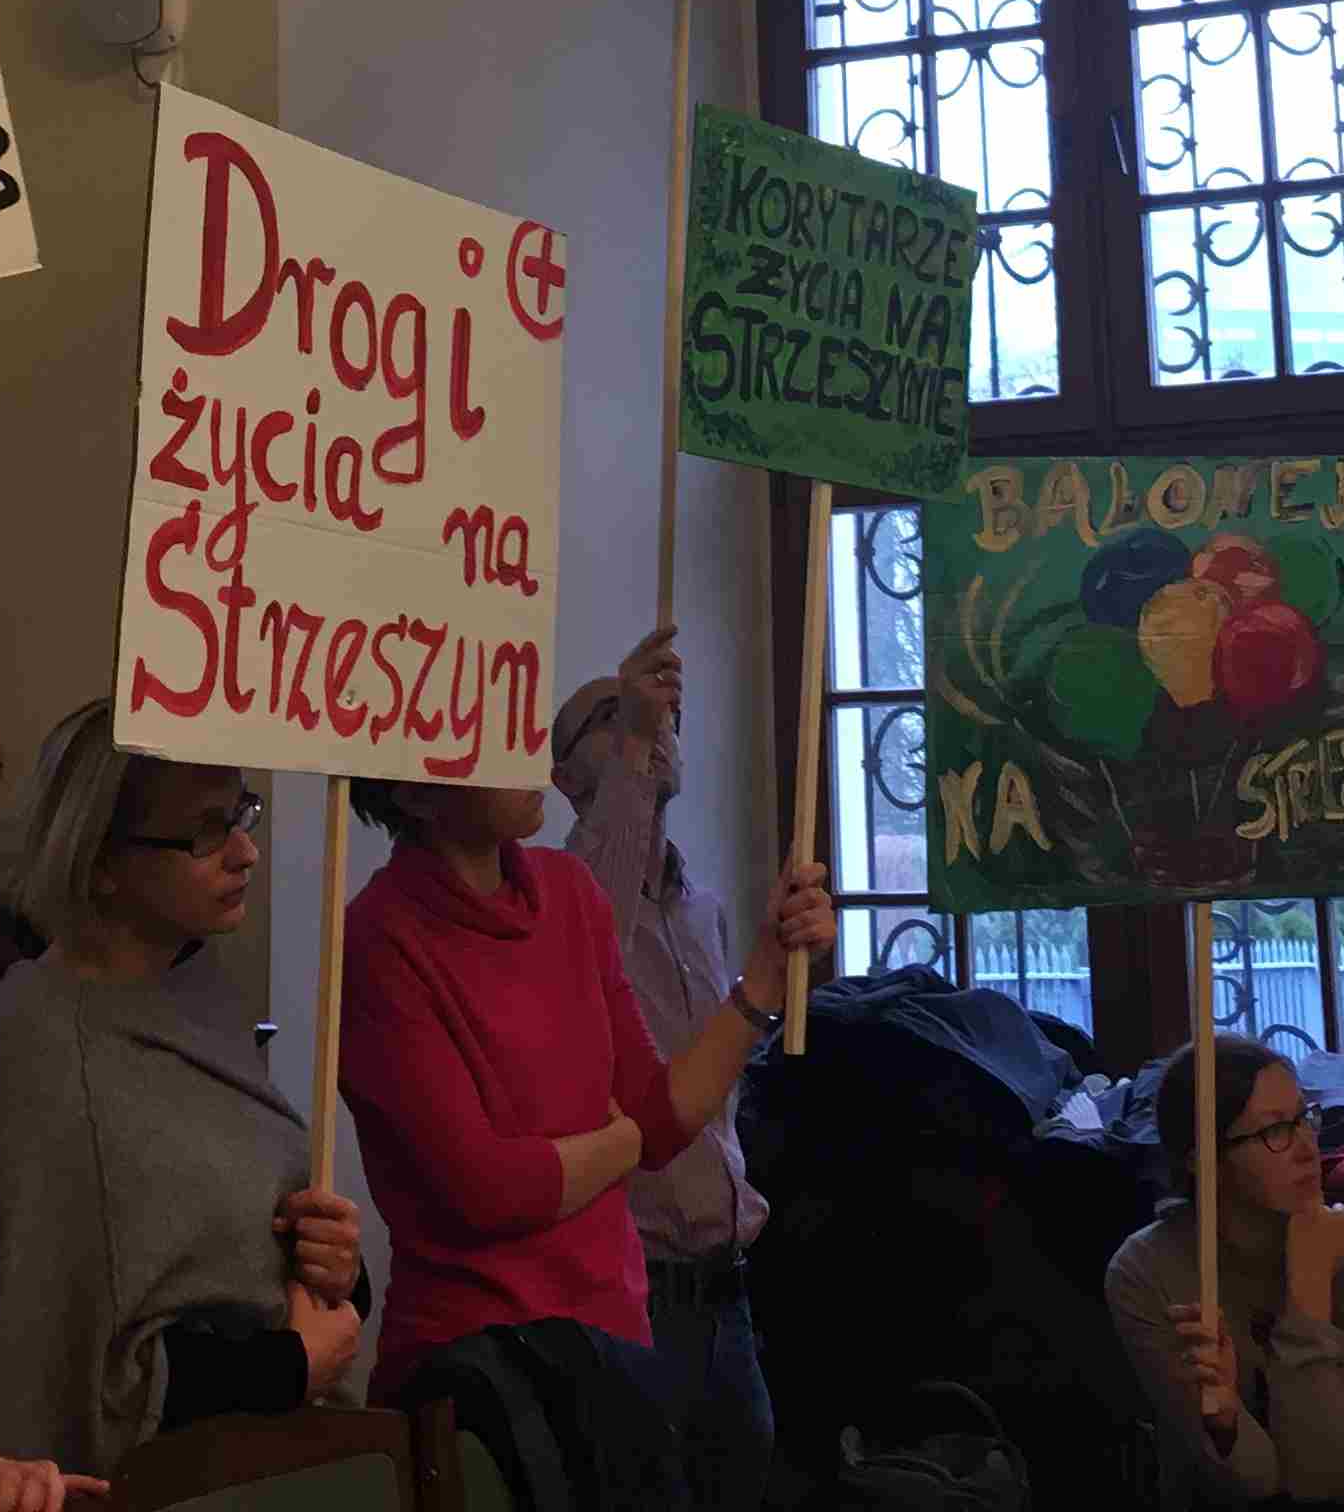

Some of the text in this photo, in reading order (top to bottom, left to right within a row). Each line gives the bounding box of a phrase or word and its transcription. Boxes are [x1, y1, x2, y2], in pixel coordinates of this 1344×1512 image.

[165, 130, 485, 485] Drogi
[722, 152, 969, 289] KORYTARZE
[884, 286, 954, 364] NA
[149, 366, 540, 597] życia na
[129, 498, 549, 780] Strzeszyn
